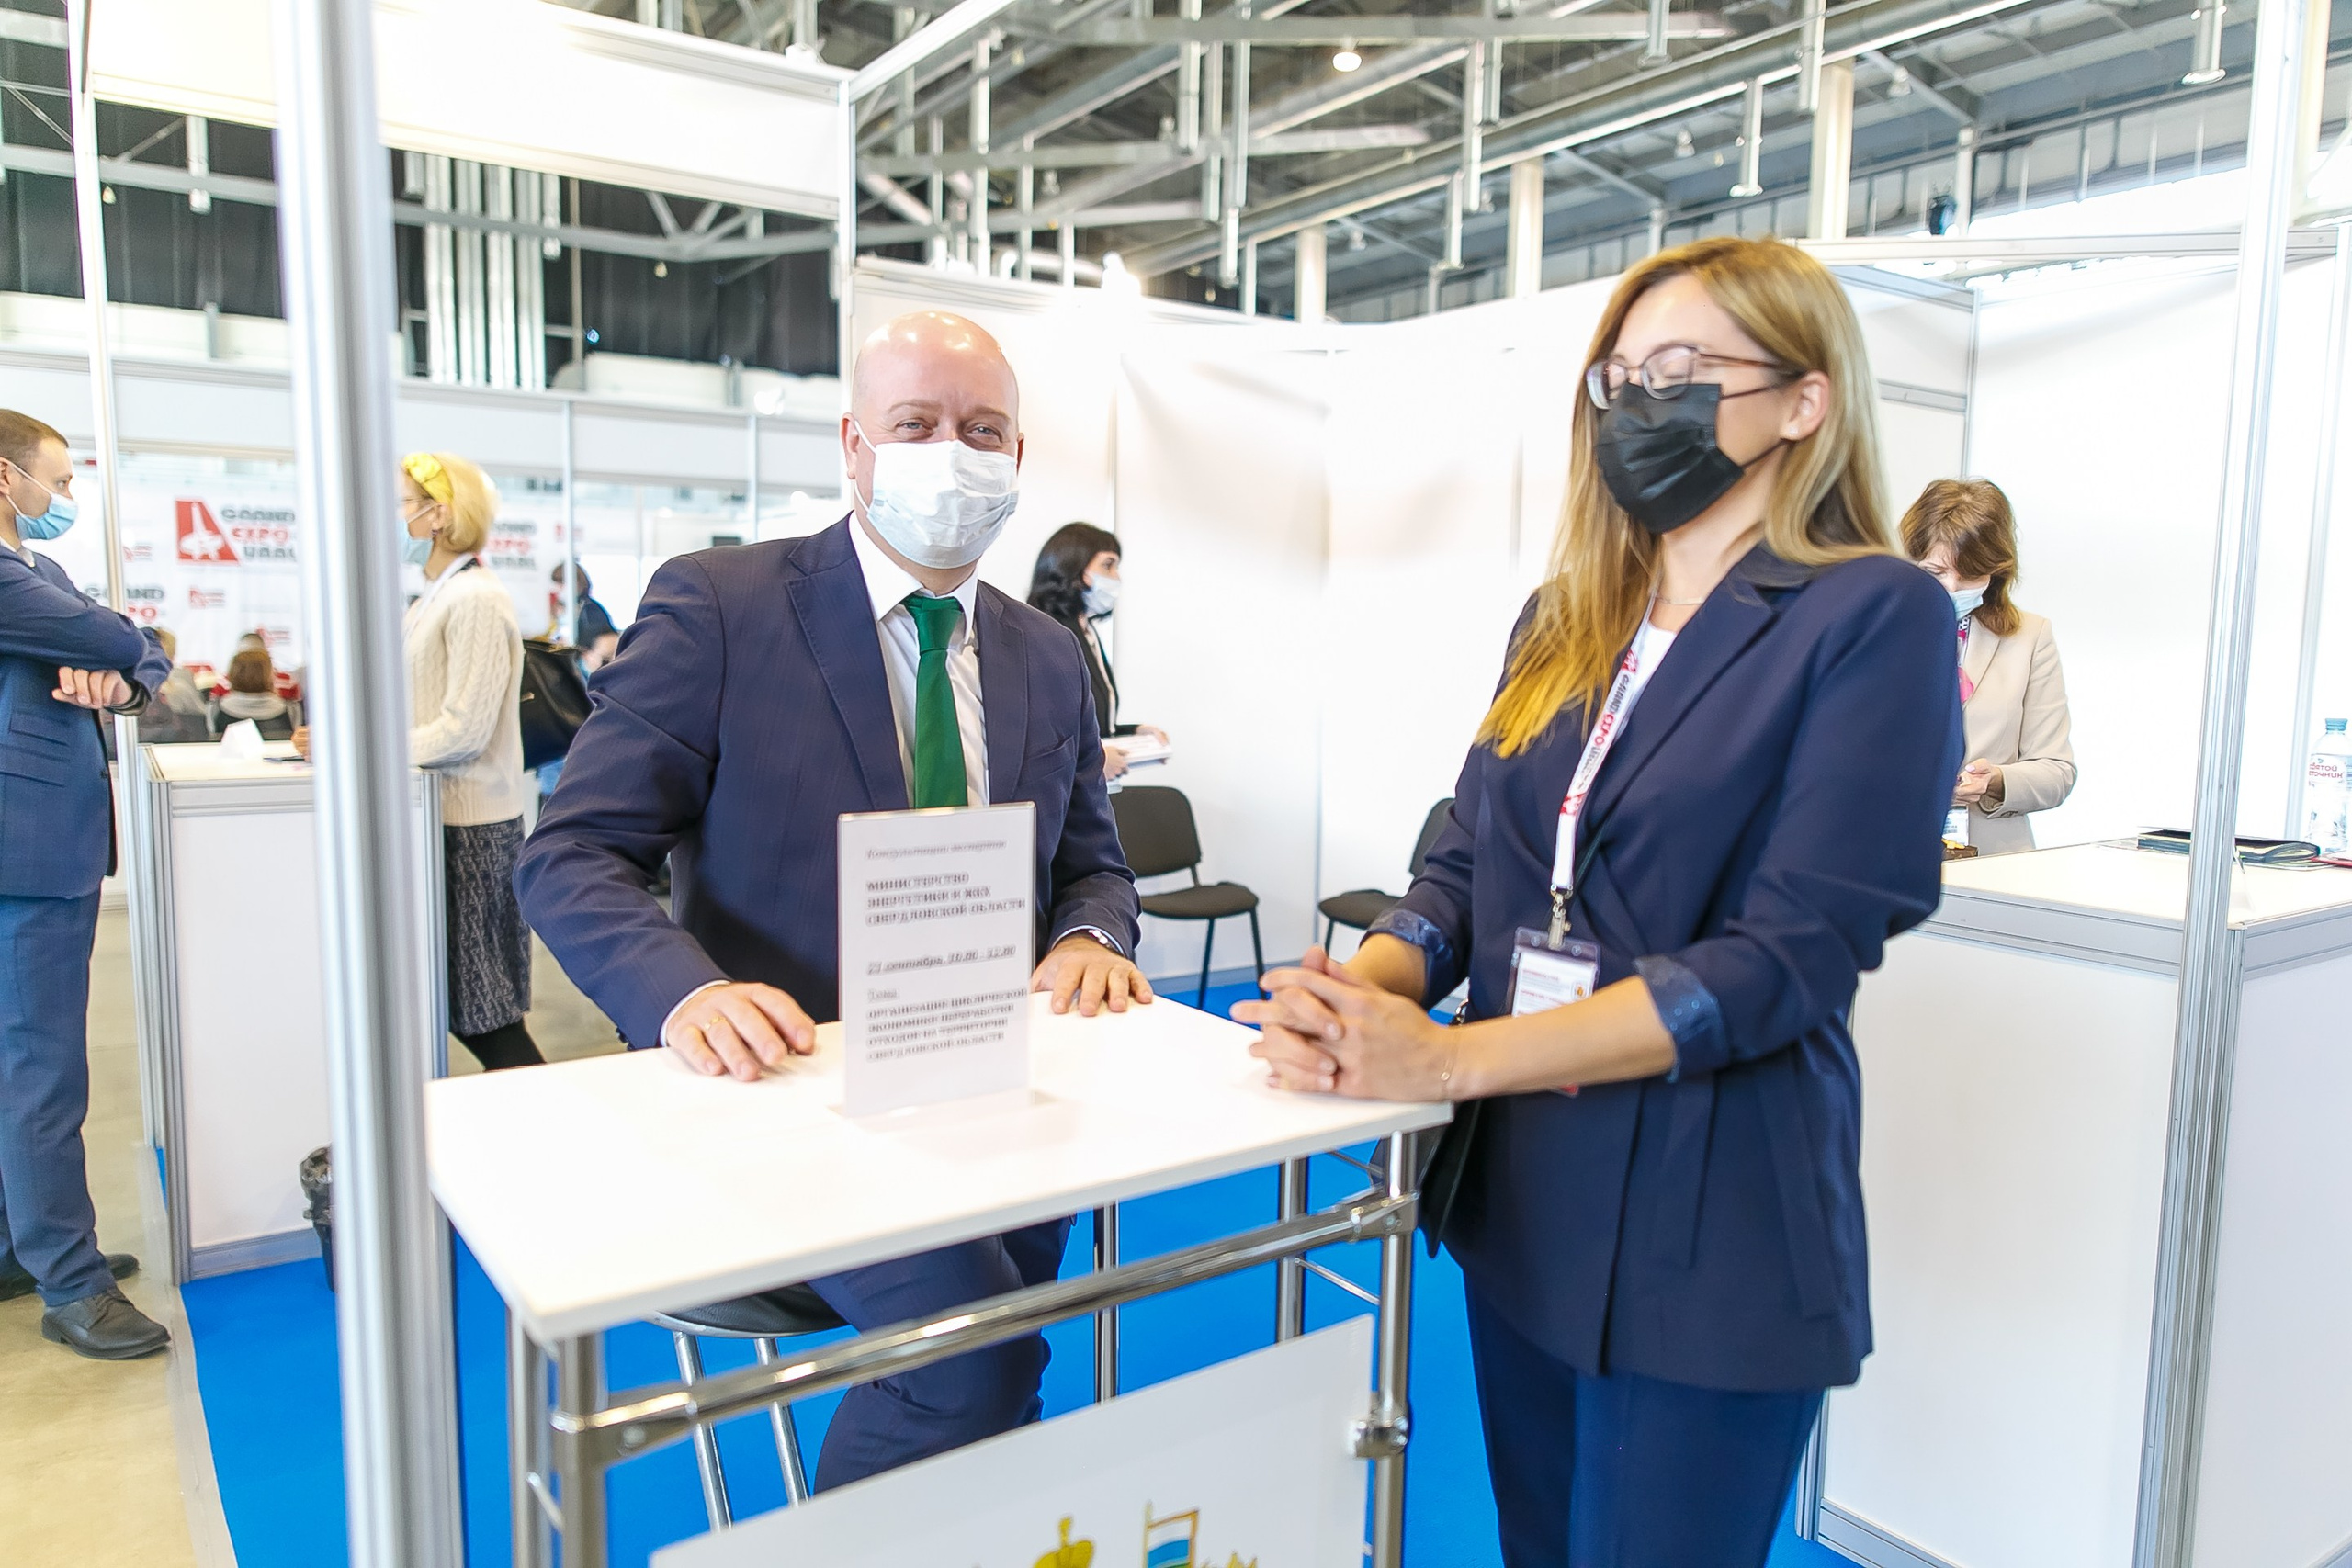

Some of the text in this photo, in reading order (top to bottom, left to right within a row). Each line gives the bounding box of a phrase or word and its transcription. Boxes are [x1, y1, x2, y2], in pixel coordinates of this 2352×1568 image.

[866, 873, 969, 891] МИНИСТЕРСТВО
[867, 891, 949, 908] ЭНЕРГЕТИКИ
[964, 886, 991, 898] ЖКХ
[866, 897, 1026, 925] СВЕРДЛОВСКОЙ ОБЛАСТИ
[956, 1032, 1004, 1047] ОБЛАСТИ
